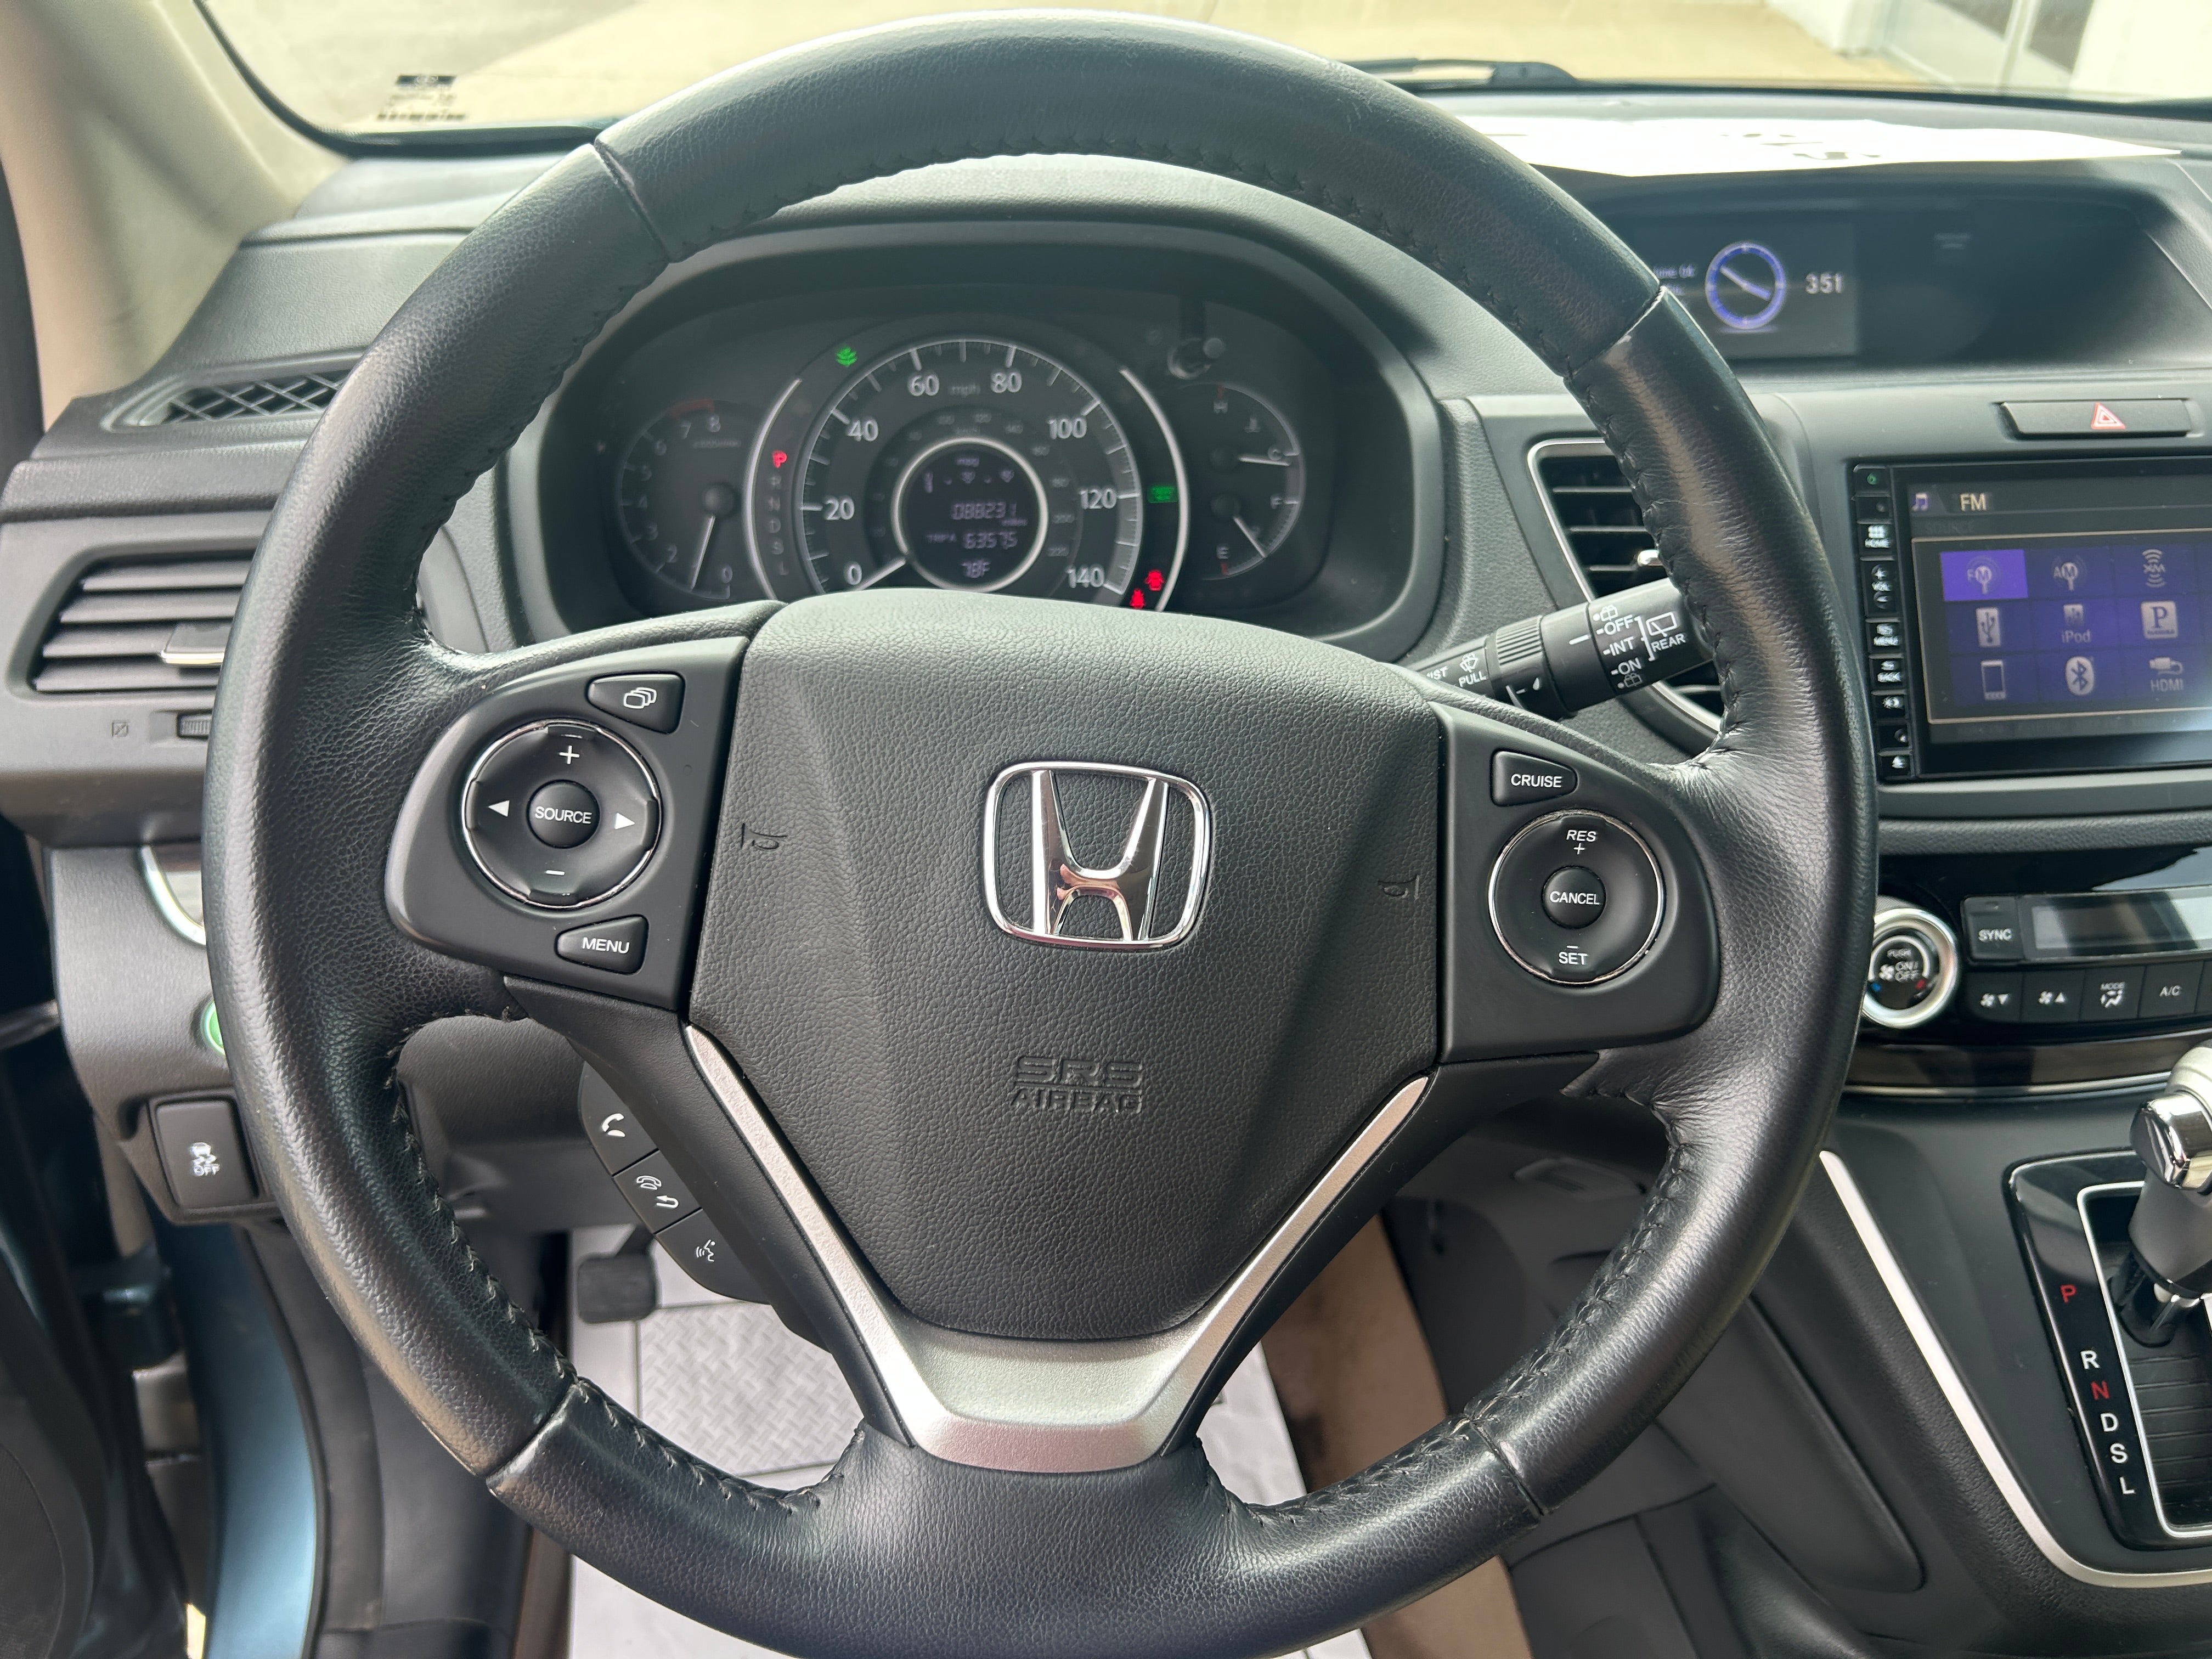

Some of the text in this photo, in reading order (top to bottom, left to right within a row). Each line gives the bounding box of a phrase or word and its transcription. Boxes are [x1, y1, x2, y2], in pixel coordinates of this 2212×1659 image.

[907, 375, 940, 396] 60
[990, 373, 1022, 393] 80
[847, 420, 878, 442] 40
[1047, 418, 1087, 439] 100
[772, 450, 787, 469] P
[1079, 488, 1116, 509] 120
[1960, 493, 1987, 511] FM
[825, 497, 854, 520] 20
[845, 562, 862, 585] 0
[1065, 566, 1105, 589] 140
[1604, 614, 1633, 635] OFF
[1610, 636, 1634, 656] INT
[1651, 633, 1686, 653] REAR
[2062, 629, 2092, 644] iPod
[1618, 657, 1641, 675] ON
[1459, 670, 1487, 687] PULL
[2151, 678, 2183, 692] HDMI
[1510, 774, 1562, 789] CRUISE
[535, 806, 592, 825] SOURCE
[1566, 830, 1597, 843] RES
[1549, 891, 1600, 906] CANCEL
[1978, 928, 2012, 942] SYNC
[582, 937, 630, 953] MENU
[1887, 948, 1911, 958] PUSH
[1558, 952, 1587, 966] SET
[1895, 970, 1919, 983] OFF
[2100, 981, 2126, 990] MODE
[2159, 985, 2182, 997] A/C
[1017, 1055, 1143, 1087] SRS
[1010, 1086, 1143, 1114] AIRBAG
[193, 1163, 220, 1177] OFF
[2060, 1284, 2077, 1303] P
[2080, 1350, 2099, 1369] R
[2091, 1381, 2109, 1400] N
[2100, 1413, 2118, 1432] D
[2109, 1444, 2128, 1464] S
[2119, 1476, 2136, 1495] L
